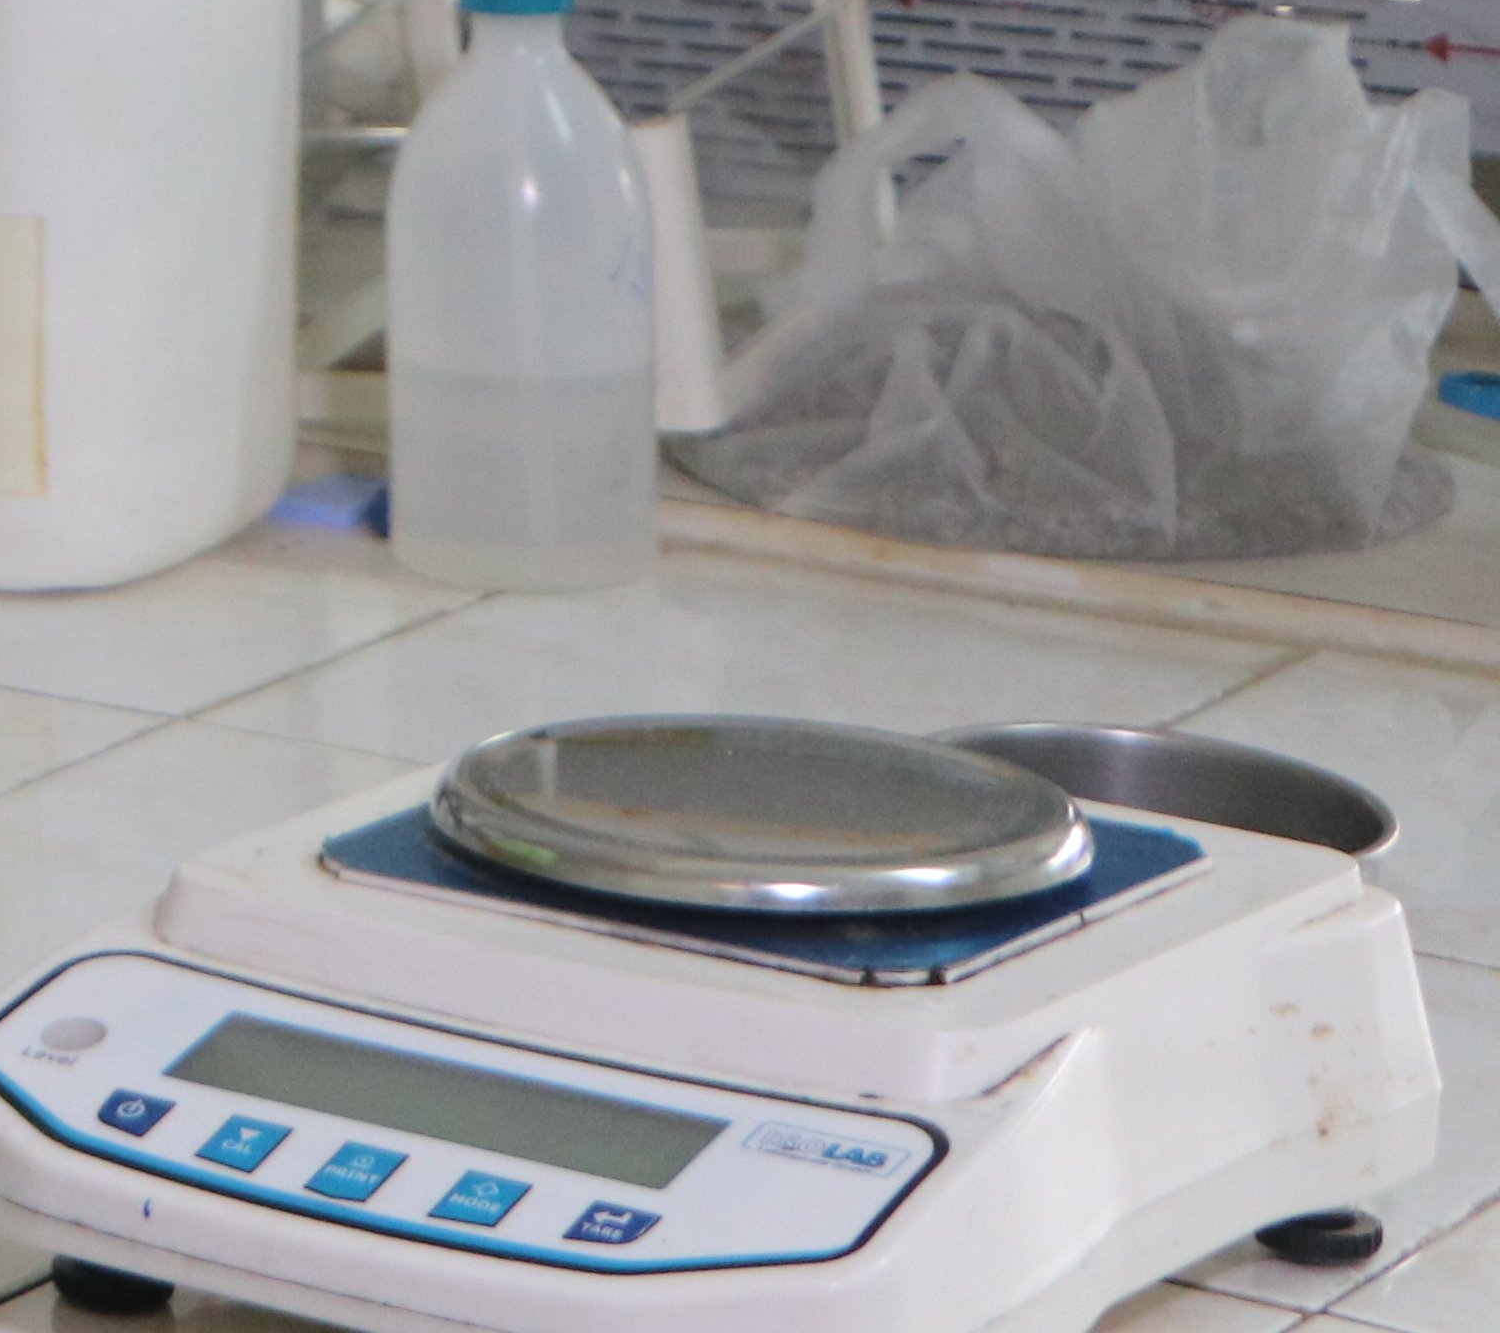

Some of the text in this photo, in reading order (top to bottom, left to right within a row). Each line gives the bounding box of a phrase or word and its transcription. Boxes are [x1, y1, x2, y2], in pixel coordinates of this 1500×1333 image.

[21, 1044, 78, 1067] Level
[221, 1138, 252, 1155] CAL
[323, 1163, 380, 1184] PRINT
[449, 1192, 504, 1213] MODE
[581, 1221, 625, 1239] TARE
